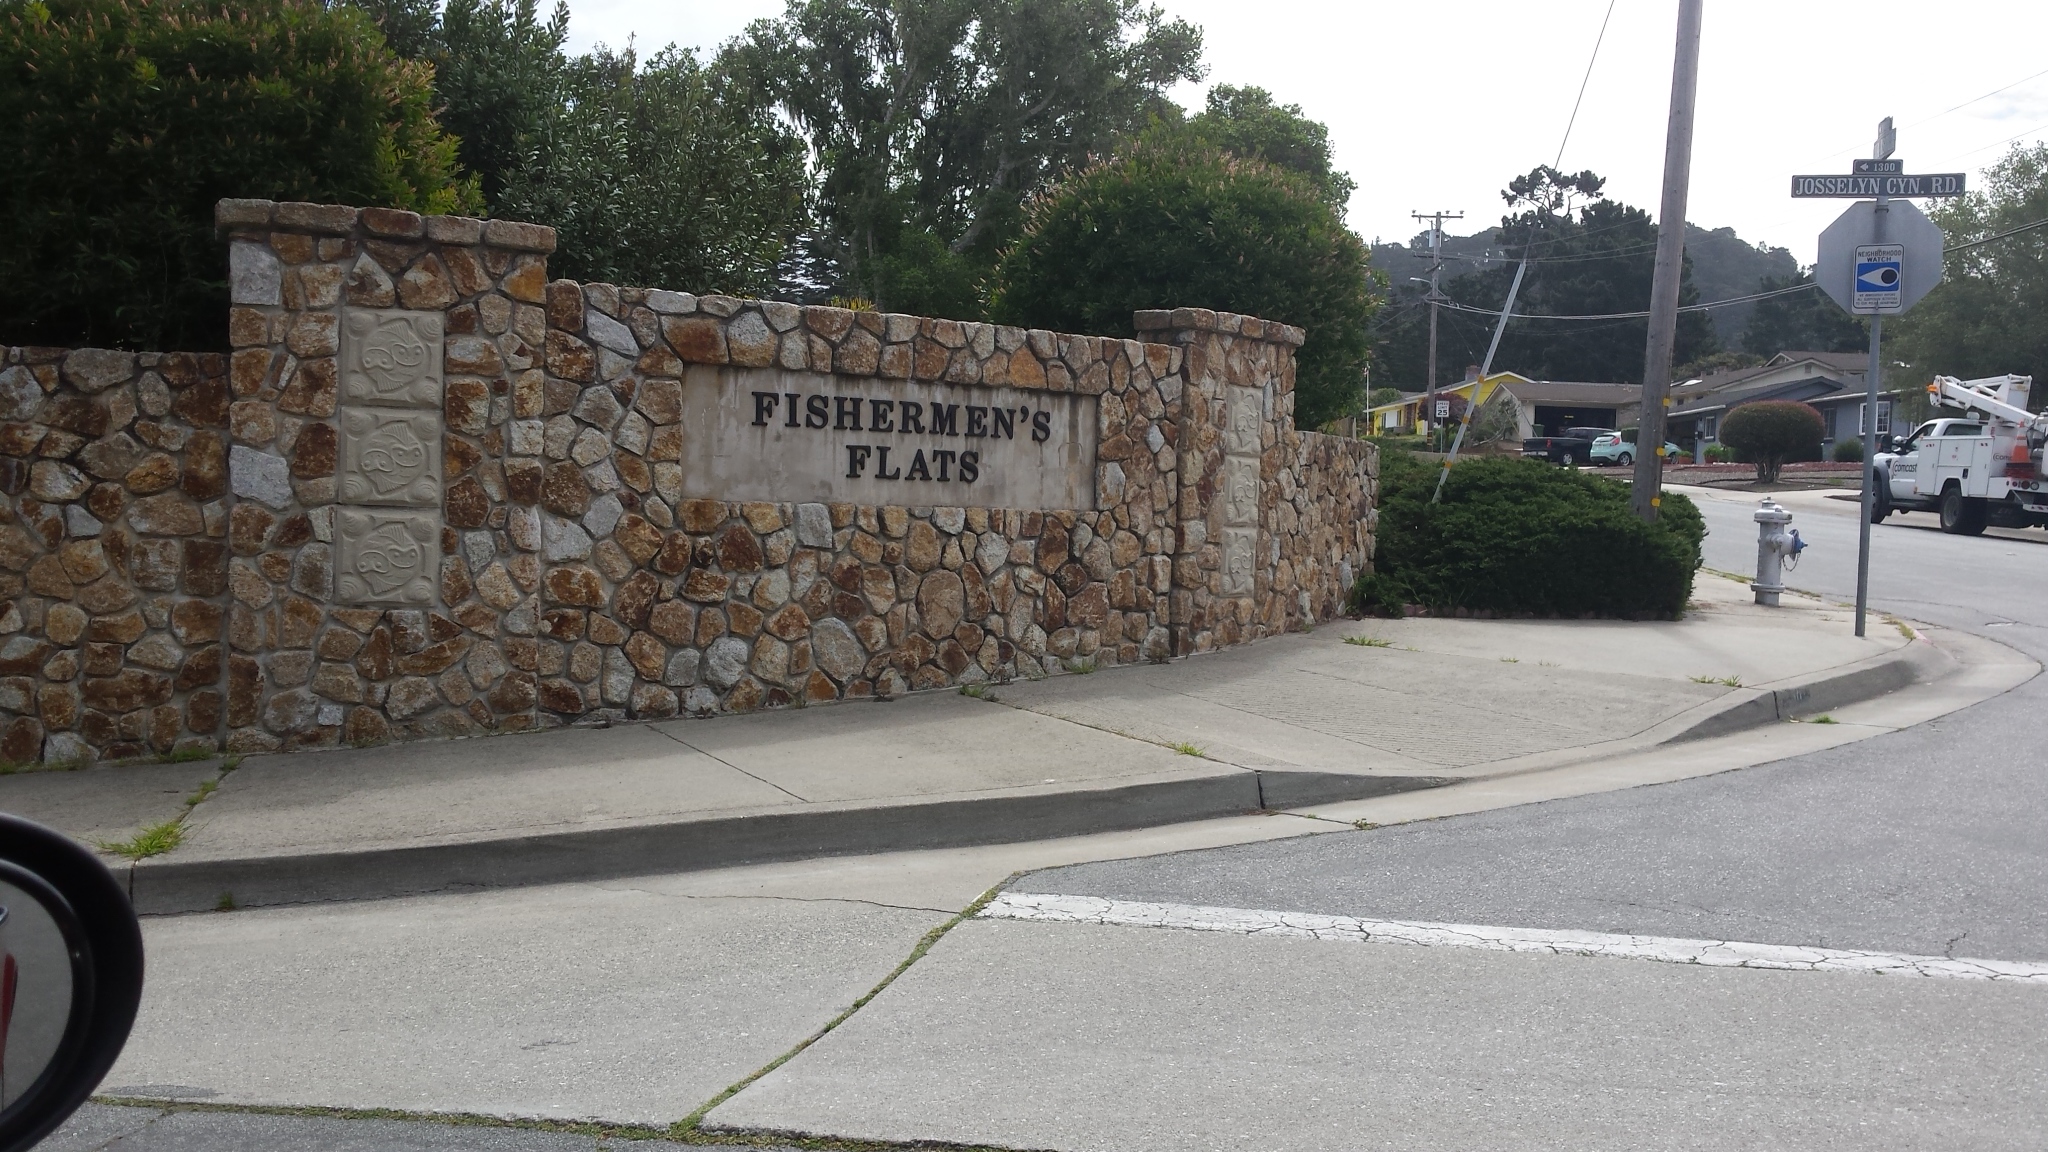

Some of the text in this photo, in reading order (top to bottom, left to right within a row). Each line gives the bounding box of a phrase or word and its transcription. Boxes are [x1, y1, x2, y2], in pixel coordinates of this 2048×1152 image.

[1873, 162, 1895, 172] 1300
[1795, 176, 1961, 195] JOSSELYN CYN. RD.
[751, 391, 1051, 442] FISHERMEN'S
[845, 444, 979, 484] FLATS
